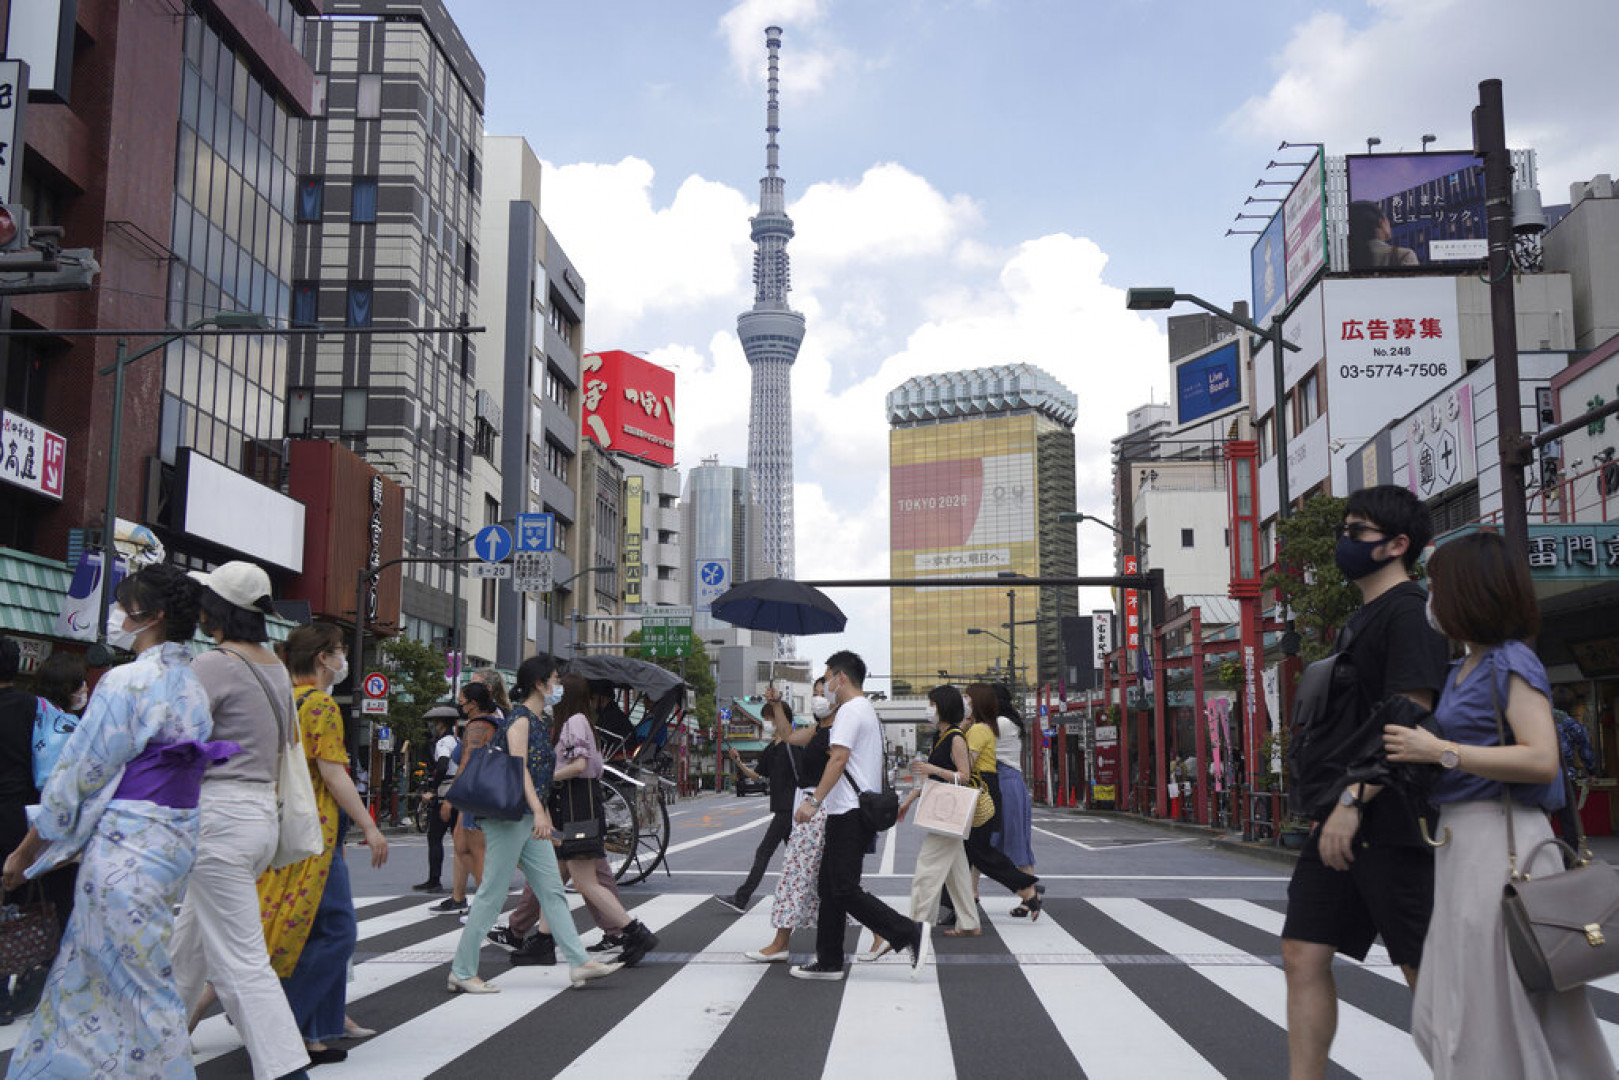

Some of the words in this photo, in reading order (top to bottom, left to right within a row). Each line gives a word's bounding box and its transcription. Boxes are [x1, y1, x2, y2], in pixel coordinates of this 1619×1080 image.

[1341, 318, 1443, 341] 広告募集
[1340, 363, 1448, 379] 03-5774-7506
[898, 497, 936, 512] TOKYO
[938, 494, 968, 508] 2020
